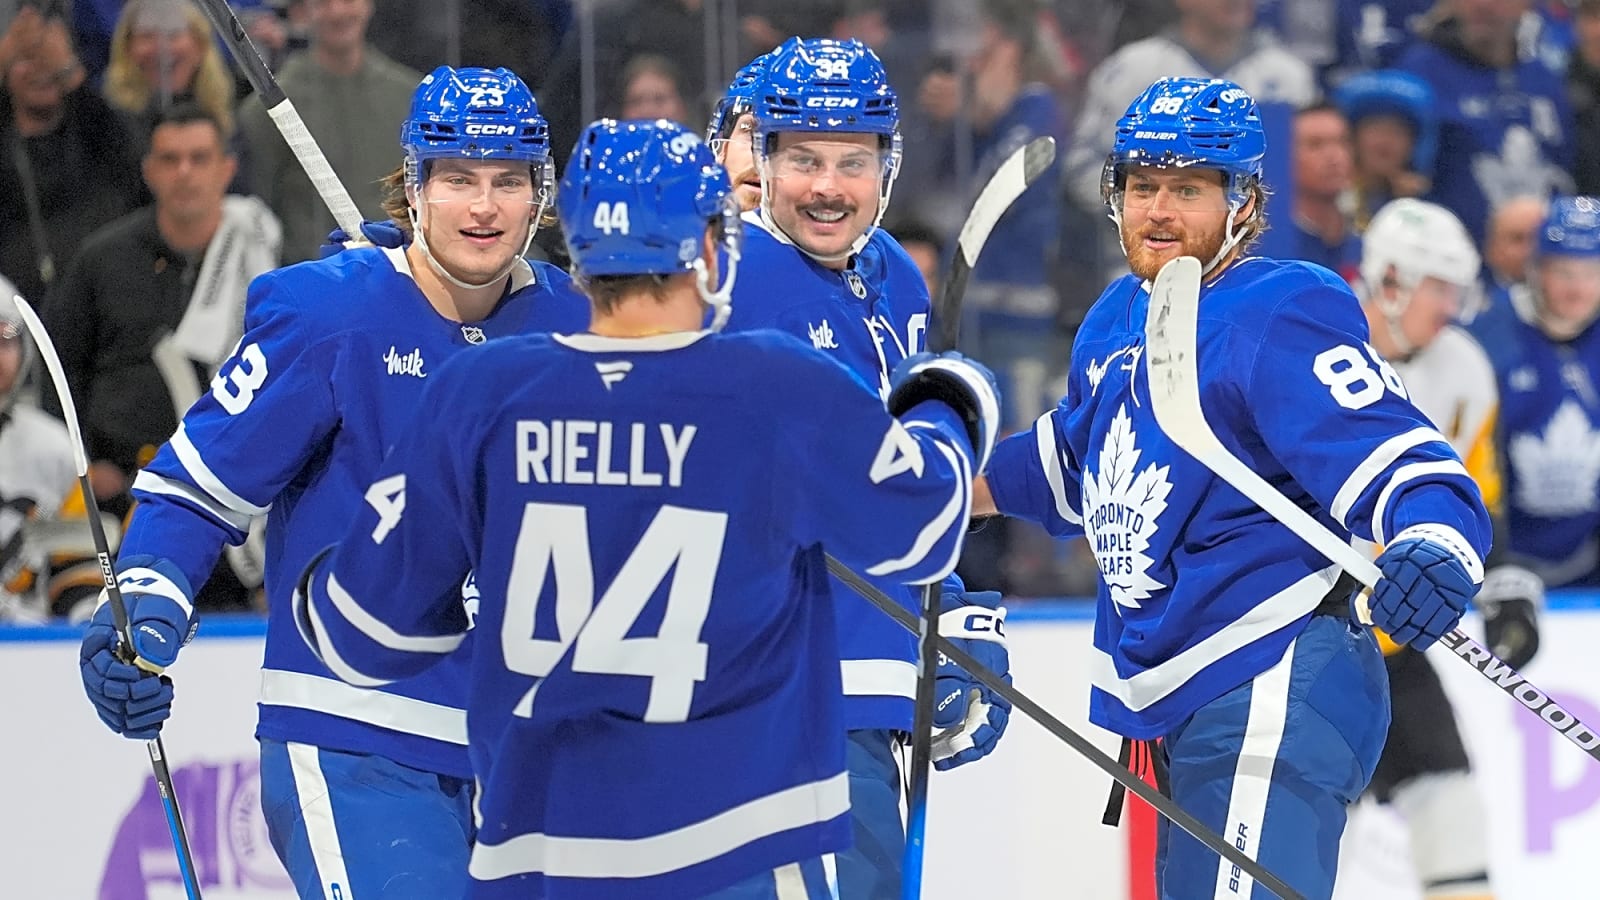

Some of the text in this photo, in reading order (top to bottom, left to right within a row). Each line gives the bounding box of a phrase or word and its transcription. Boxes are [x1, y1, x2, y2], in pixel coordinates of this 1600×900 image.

[815, 58, 849, 79] 34
[470, 86, 505, 107] 23
[806, 96, 860, 109] CCM
[1150, 96, 1185, 115] 88
[465, 124, 516, 136] CCM
[1134, 130, 1179, 142] BAUER
[593, 201, 630, 235] 44
[209, 334, 269, 416] 3
[382, 345, 428, 379] Milk
[515, 419, 698, 488] RIELLY
[1088, 502, 1144, 536] TORONTO
[1096, 532, 1133, 553] MAPLE
[98, 552, 117, 588] CCM
[501, 502, 729, 723] 44
[1228, 822, 1249, 894] BAER
